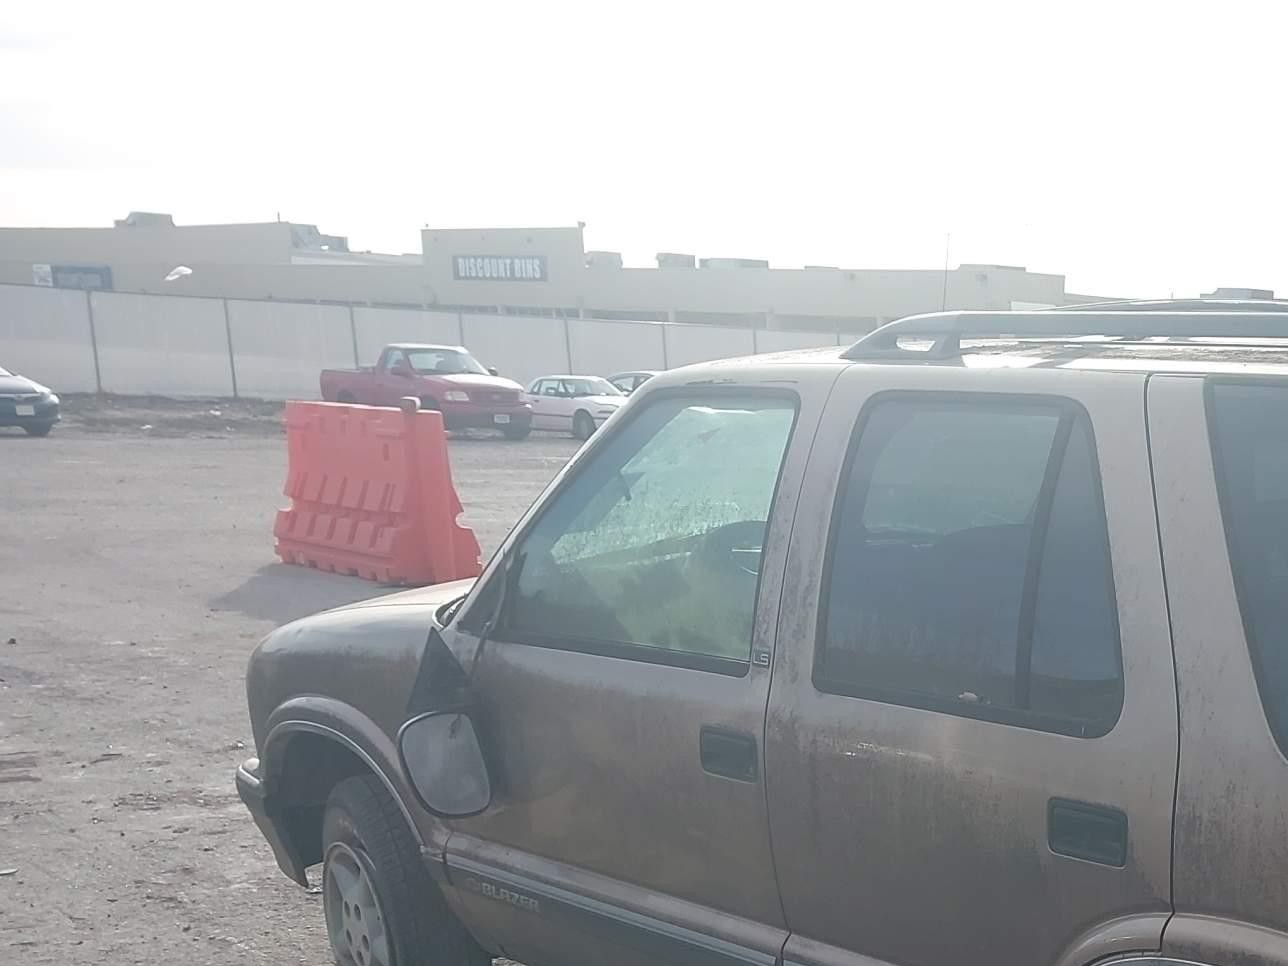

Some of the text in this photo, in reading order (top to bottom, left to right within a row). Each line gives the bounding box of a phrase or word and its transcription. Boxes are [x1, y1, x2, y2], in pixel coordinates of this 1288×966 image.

[457, 257, 511, 277] DISCOUNT
[753, 652, 769, 666] LS
[481, 882, 540, 912] BLAZER
